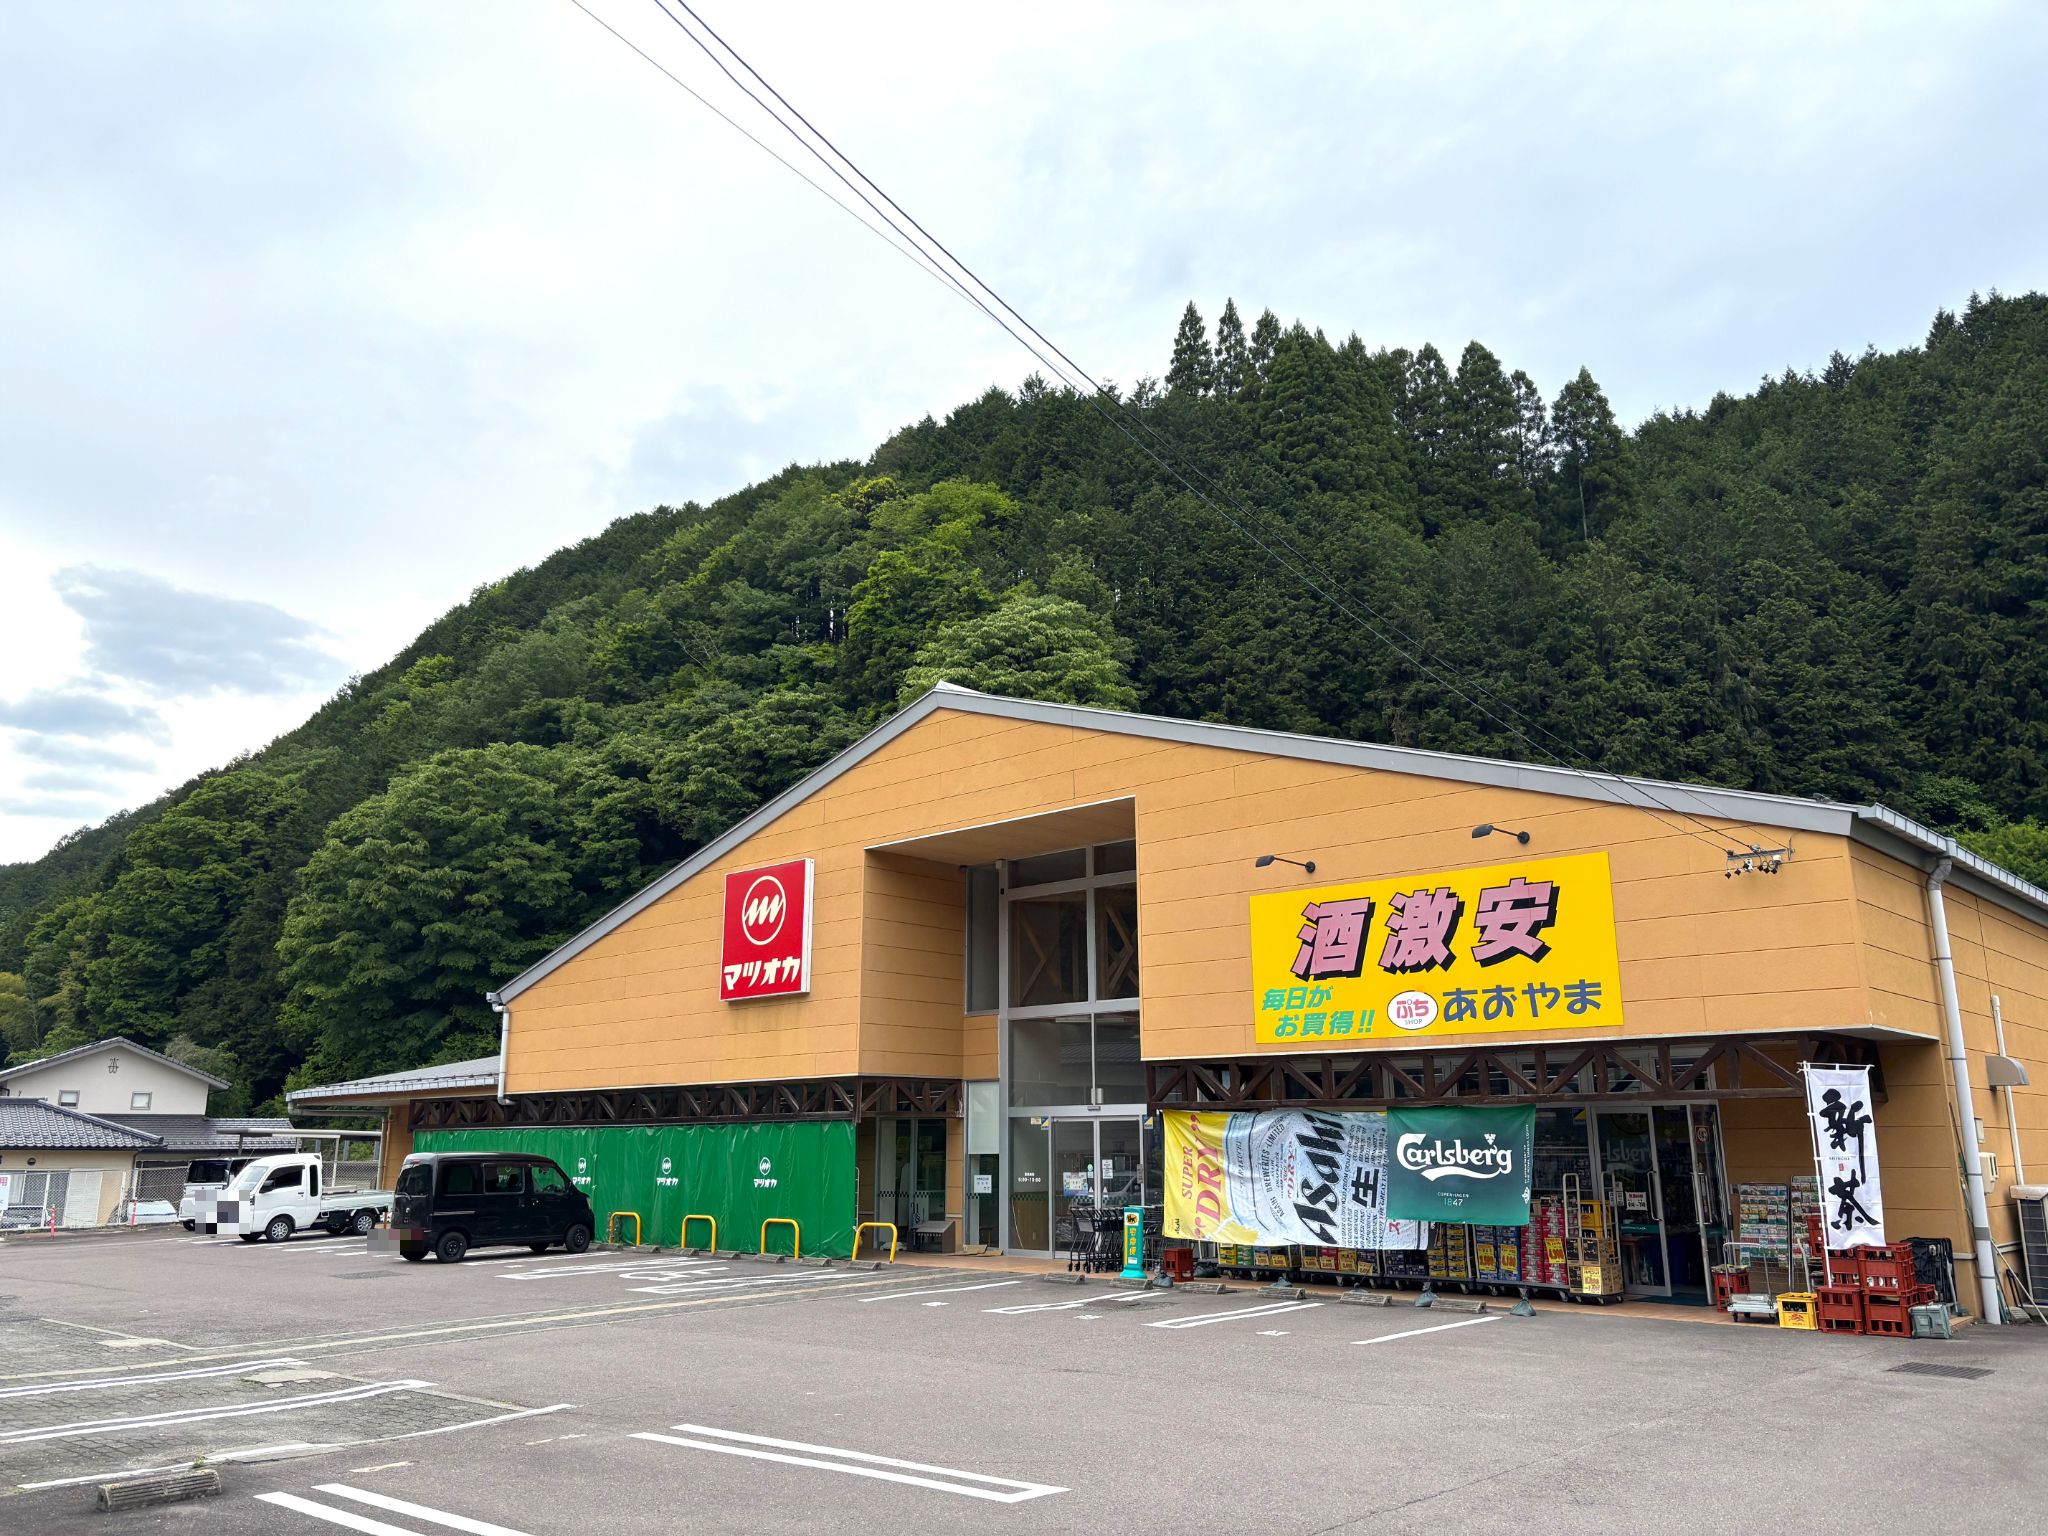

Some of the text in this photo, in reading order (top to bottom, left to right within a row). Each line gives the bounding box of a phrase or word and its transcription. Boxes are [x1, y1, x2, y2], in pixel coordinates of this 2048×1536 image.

[1290, 877, 1560, 981] 酒激安
[723, 955, 801, 991] マツオカ
[1262, 984, 1334, 1012] 毎日が
[1397, 999, 1430, 1019] ぷち
[1442, 978, 1603, 1023] あおやま
[1181, 1145, 1194, 1200] SUPER
[1260, 1149, 1273, 1193] BREWERIES
[1396, 1133, 1513, 1175] Carlsberg
[1819, 1088, 1881, 1231] 新茶
[572, 1176, 592, 1185] マツオカ
[656, 1176, 679, 1186] マツオカ
[753, 1177, 778, 1188] マツオカ
[1293, 1112, 1346, 1245] Asahi
[1350, 1167, 1380, 1208] 生
[1444, 1198, 1463, 1207] 1847
